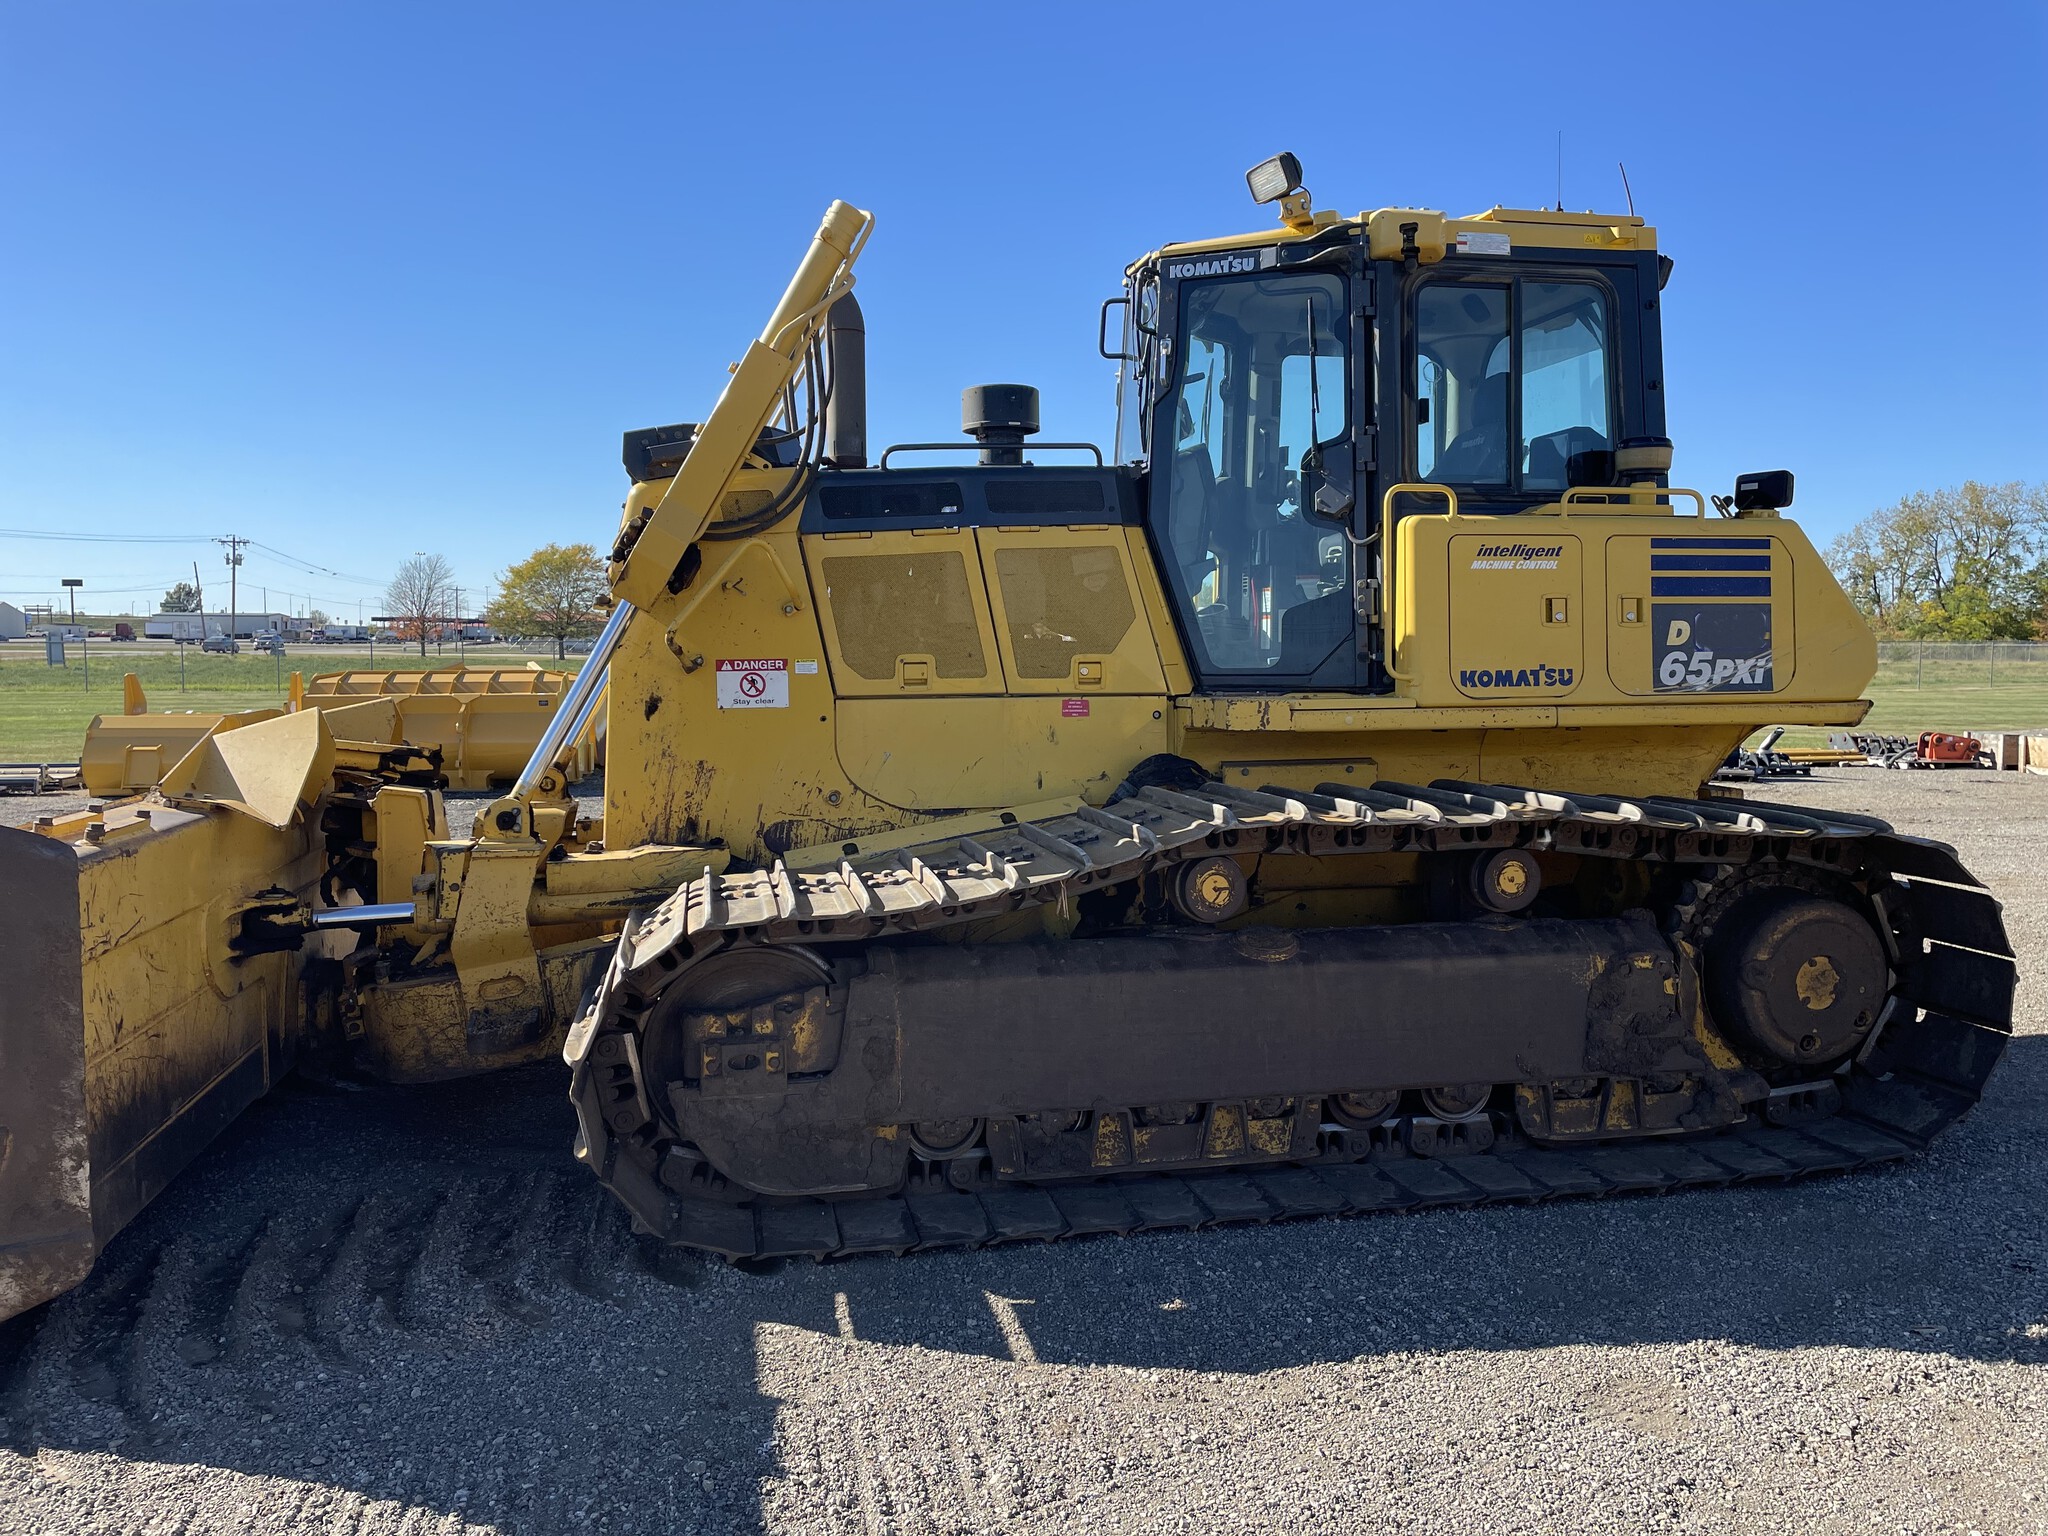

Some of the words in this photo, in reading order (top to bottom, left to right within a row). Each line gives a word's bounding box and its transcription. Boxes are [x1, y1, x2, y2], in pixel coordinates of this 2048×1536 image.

[1169, 256, 1255, 279] KOMATSU
[1476, 544, 1563, 561] intelligent
[1470, 560, 1515, 570] MACHINE
[1515, 560, 1558, 570] CONTROL
[1666, 620, 1691, 646] D
[734, 660, 783, 670] DANGER
[1460, 664, 1573, 688] KOMATSU
[733, 698, 751, 706] Stay
